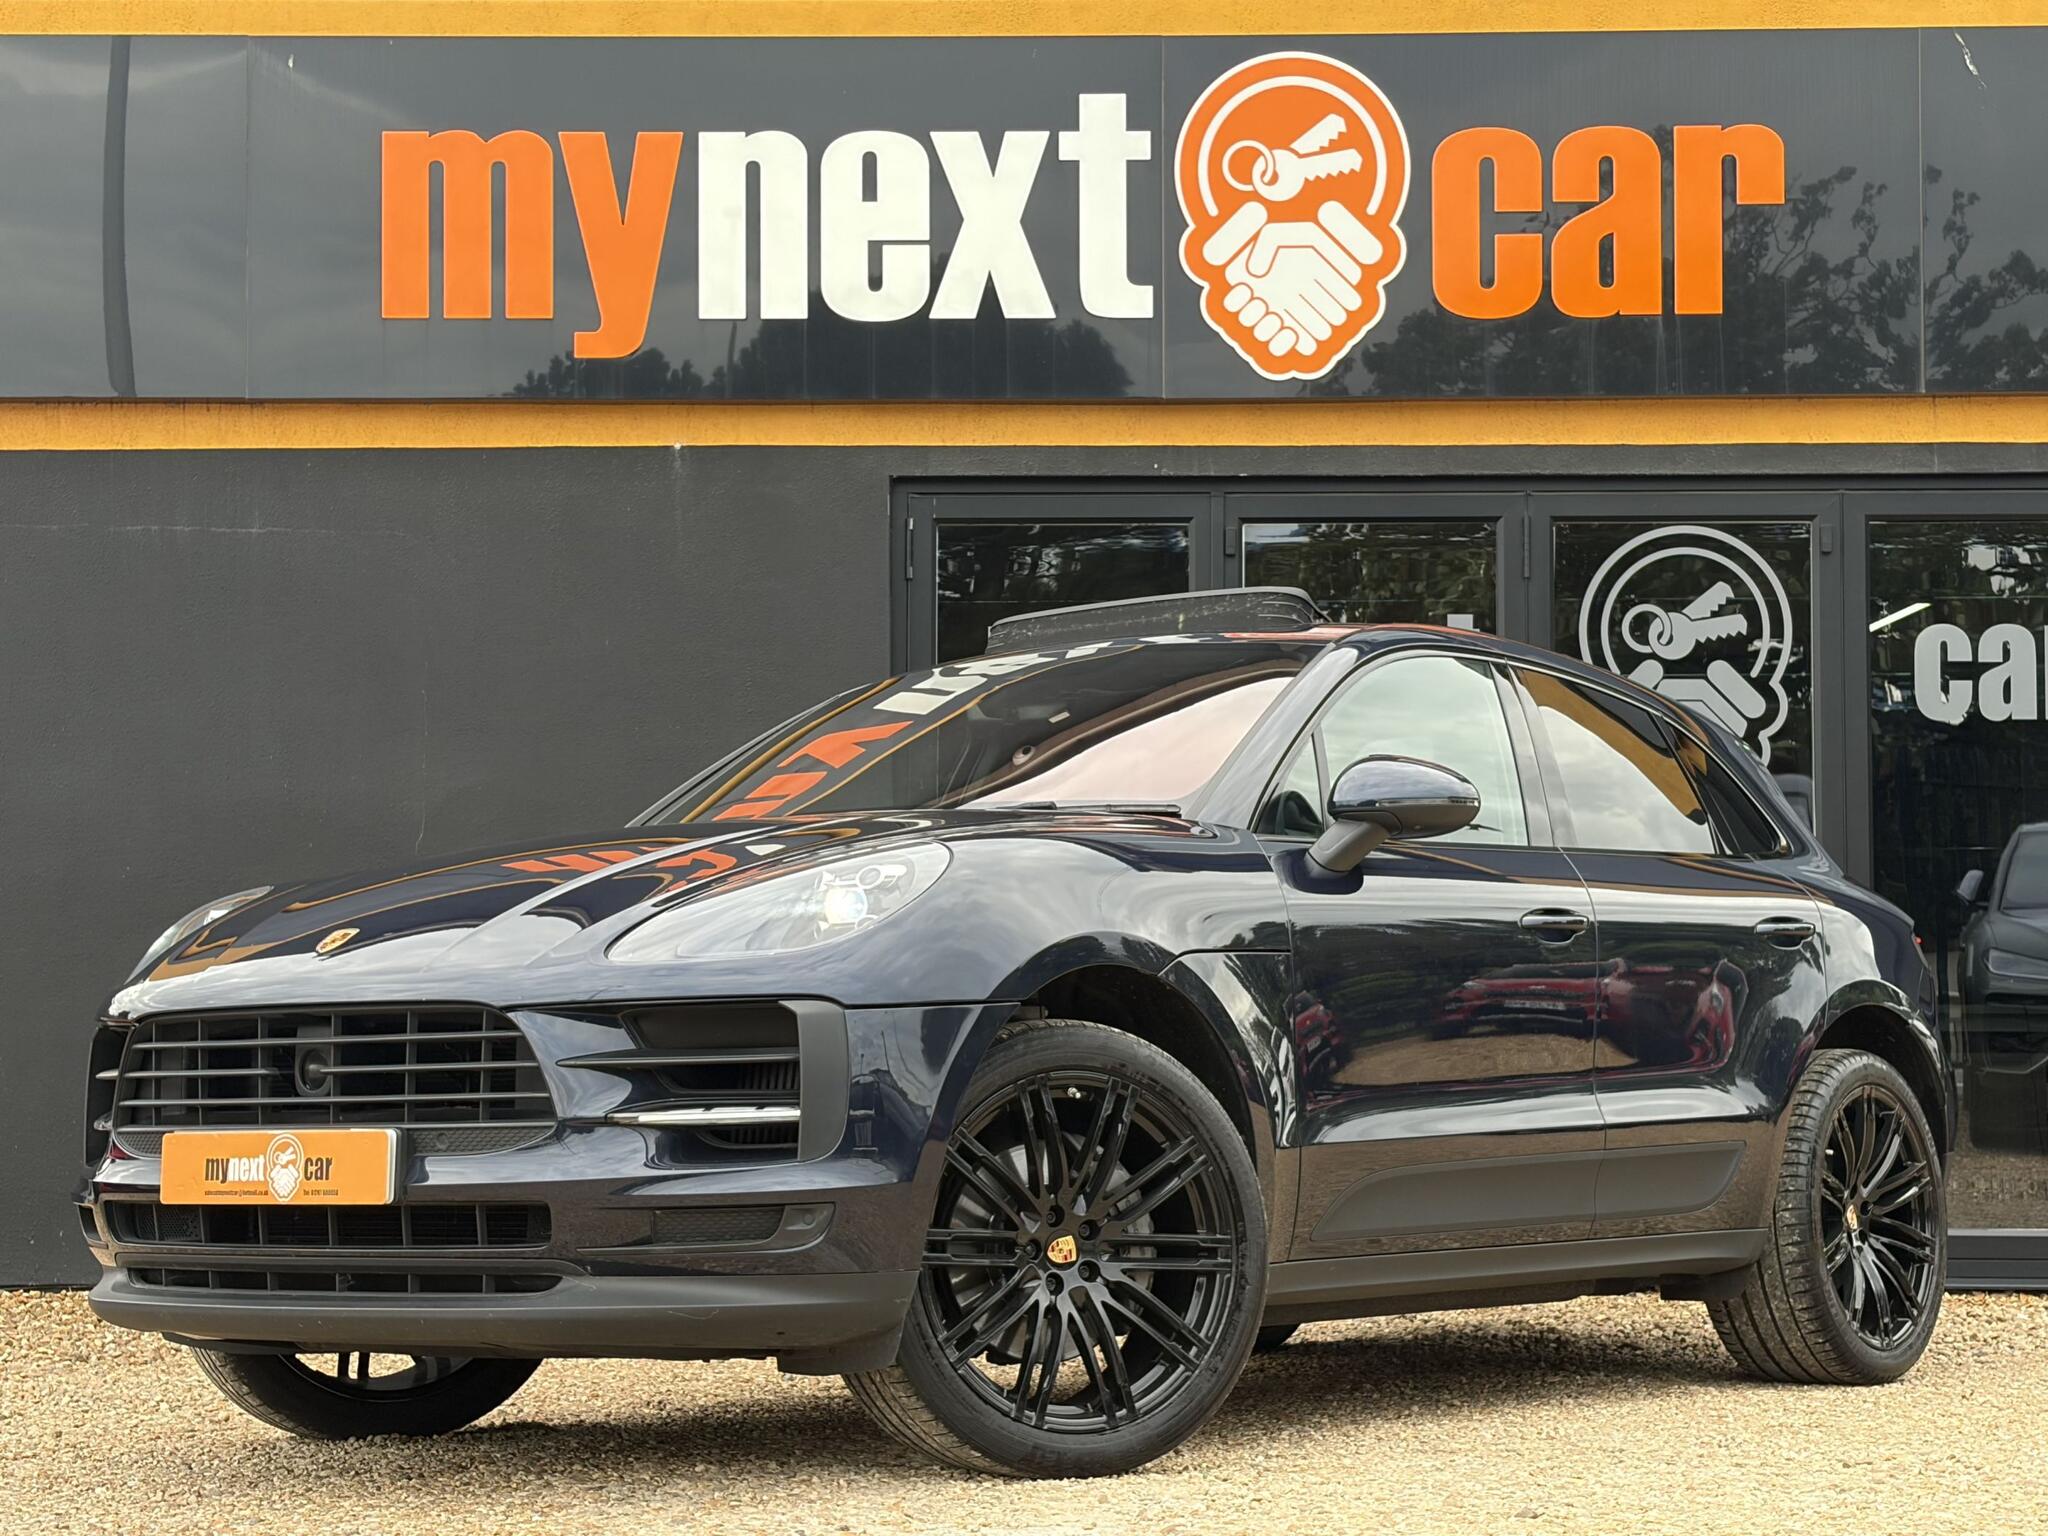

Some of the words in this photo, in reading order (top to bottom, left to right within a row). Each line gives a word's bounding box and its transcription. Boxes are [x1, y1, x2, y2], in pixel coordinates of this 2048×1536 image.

[1431, 124, 1787, 320] car
[1914, 623, 2048, 722] ca
[304, 1157, 333, 1181] car
